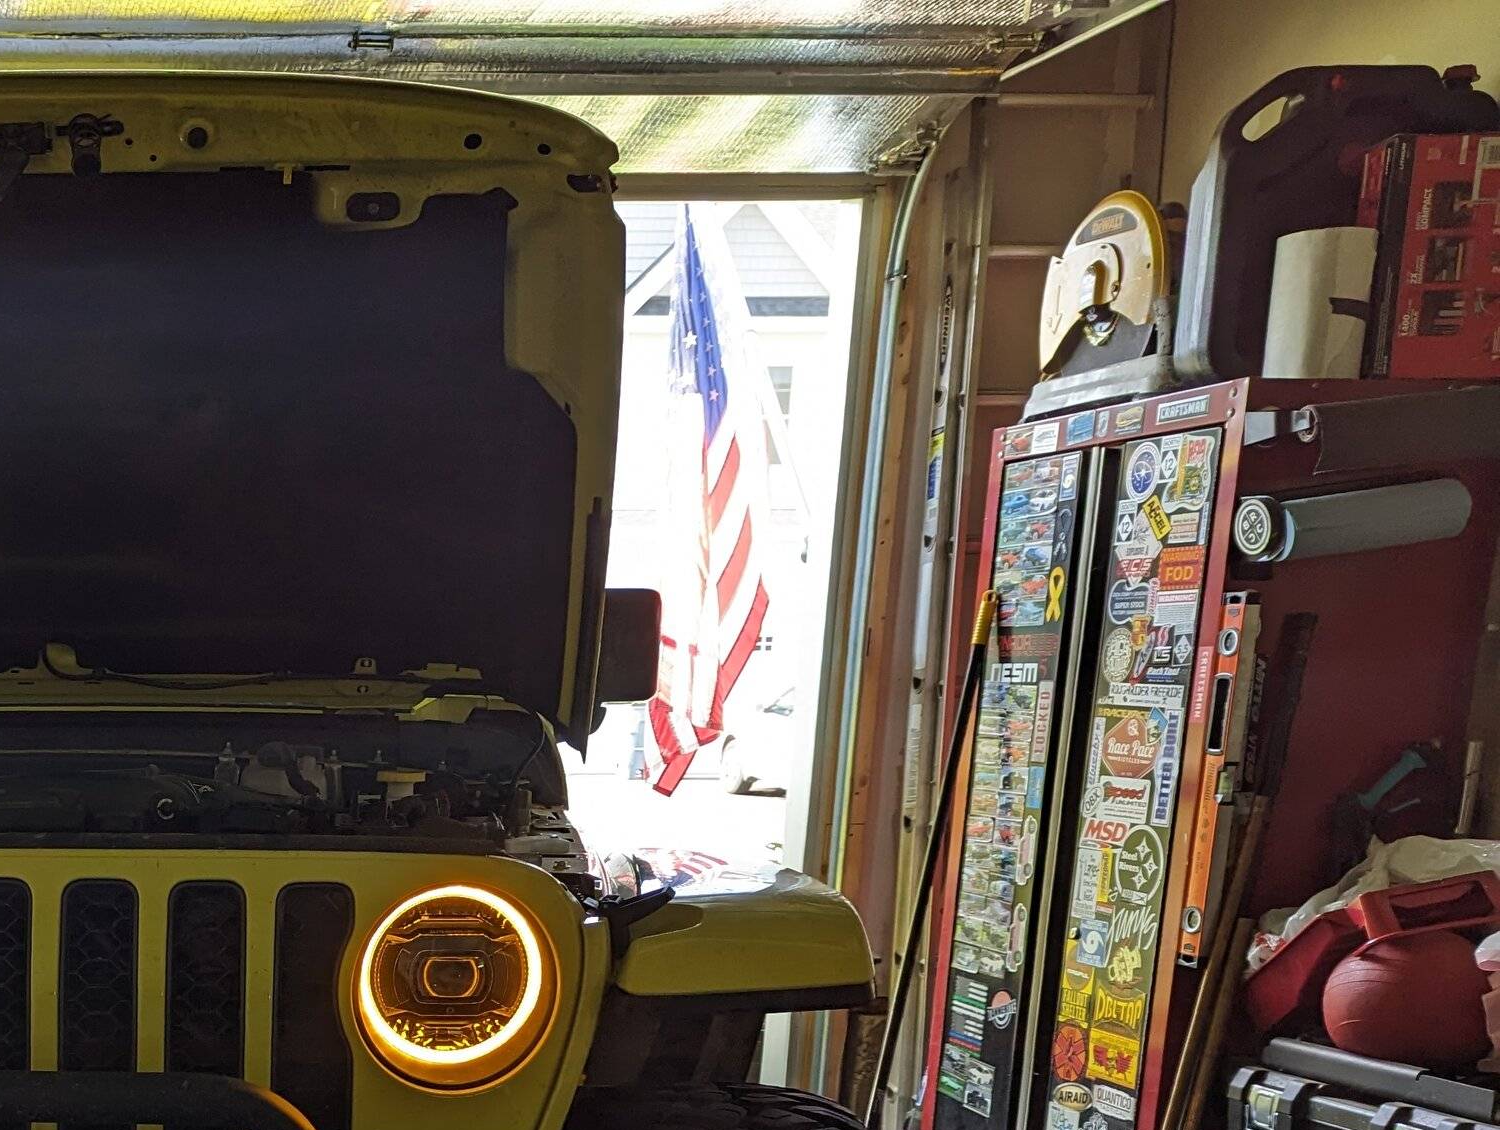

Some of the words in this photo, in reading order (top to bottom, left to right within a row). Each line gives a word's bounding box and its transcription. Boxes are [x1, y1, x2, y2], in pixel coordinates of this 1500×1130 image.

[1160, 400, 1206, 419] CRAFTSMAN
[1166, 566, 1194, 580] FOD
[1035, 690, 1051, 754] LOCKED
[1107, 738, 1131, 756] Race
[1131, 740, 1156, 758] Pace
[1084, 819, 1127, 842] MSD
[1059, 1090, 1088, 1104] AIRAID
[1097, 1087, 1132, 1109] QUANTICO
